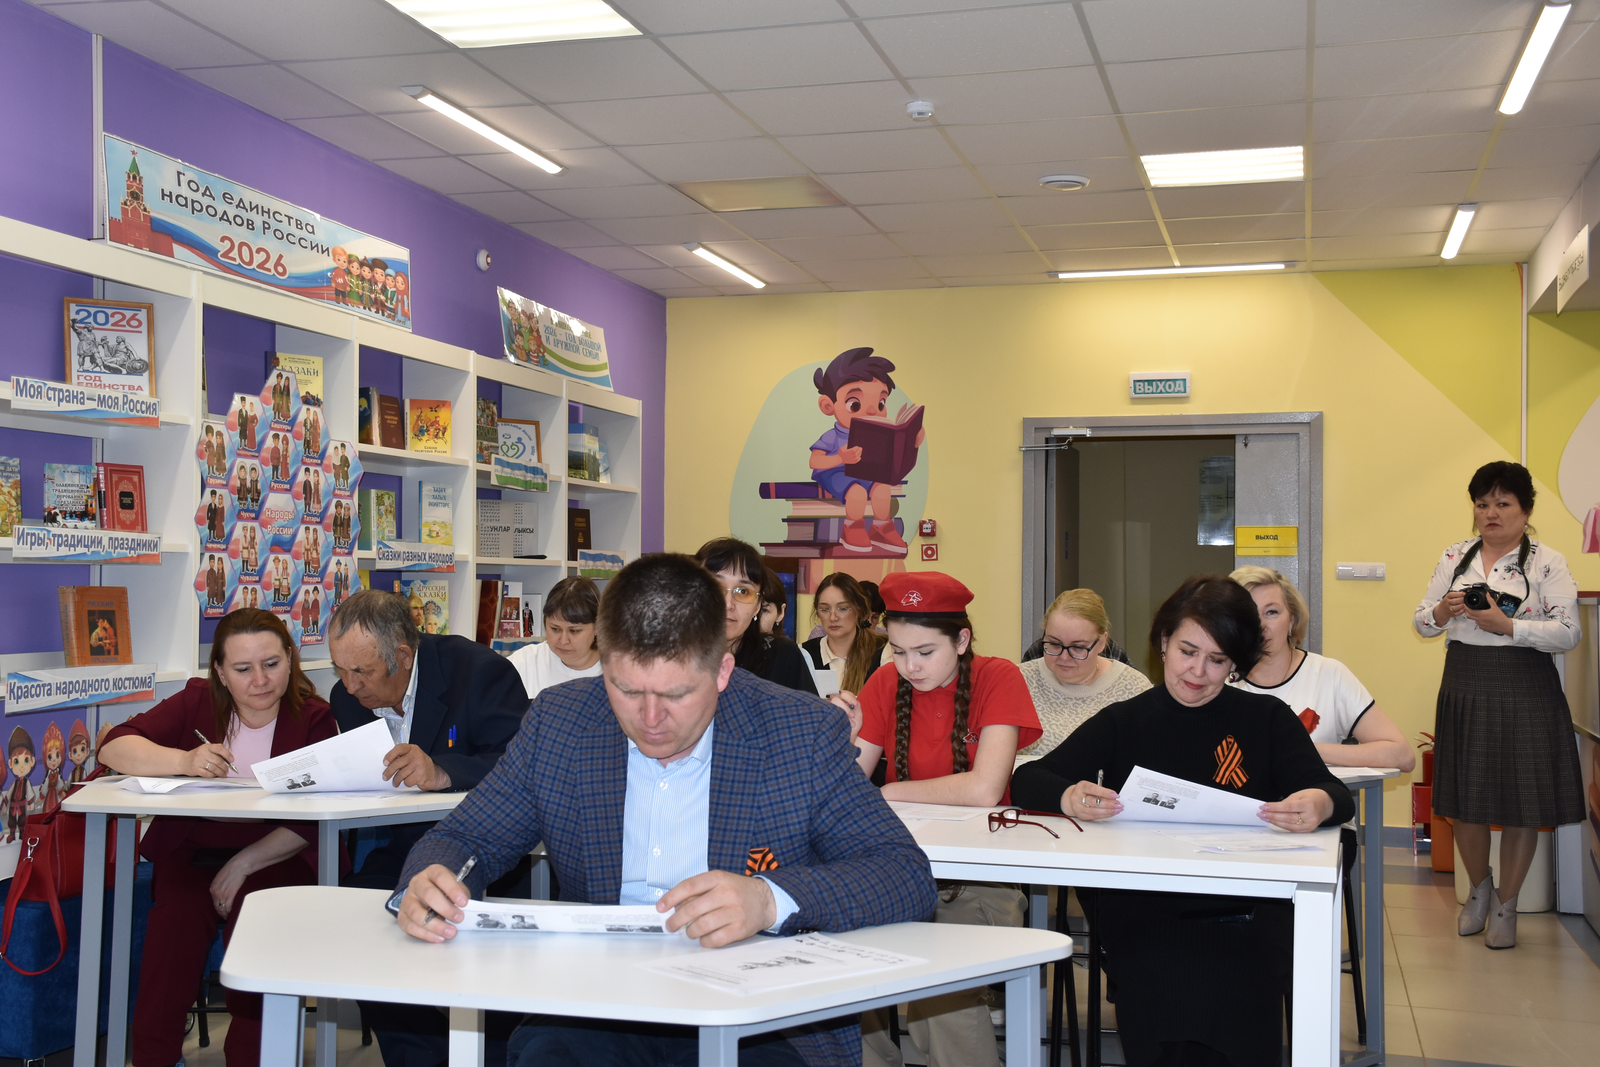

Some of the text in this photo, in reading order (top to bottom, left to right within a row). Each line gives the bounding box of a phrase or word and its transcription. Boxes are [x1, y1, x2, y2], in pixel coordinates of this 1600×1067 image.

[176, 170, 316, 236] Год единства
[160, 187, 331, 257] народов России
[218, 234, 289, 279] 2026
[75, 308, 143, 329] 2026
[545, 335, 600, 361] И ДРУЖНОЙ СЕМЬИ
[565, 332, 577, 344] ГОД
[578, 337, 602, 352] БОЛЬШОЙ
[77, 382, 144, 391] ЕДИНСТВА
[1135, 380, 1185, 394] ВЫХОД
[15, 378, 43, 400] Моя
[46, 385, 86, 407] страна
[97, 393, 119, 411] моя
[122, 394, 157, 416] Россия
[207, 477, 226, 485] Грузины
[271, 481, 290, 489] Русские
[240, 510, 255, 519] Чукчи
[265, 508, 294, 520] Народы
[303, 515, 321, 523] Татары
[267, 525, 293, 535] России
[17, 527, 159, 556] Игры, традиции, праздники
[377, 546, 453, 565] Сказки разных народов
[240, 574, 259, 582] Чуваши
[8, 675, 153, 704] Красота народного костюма
